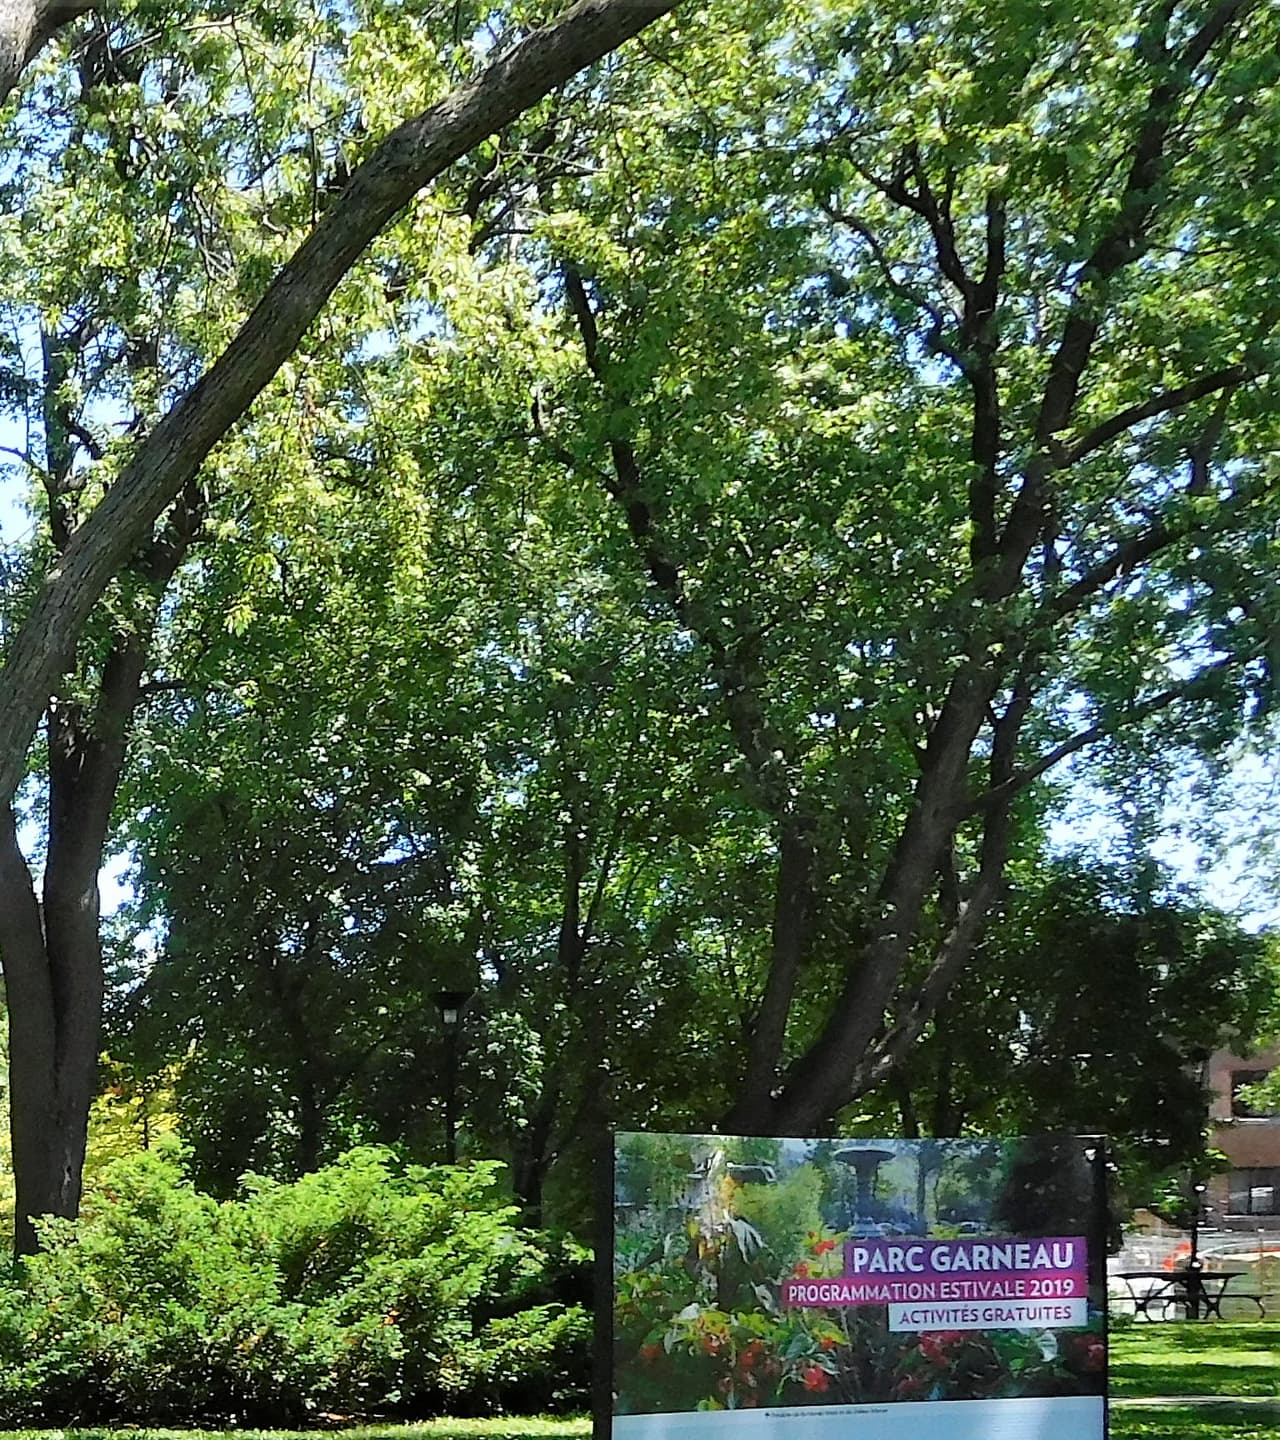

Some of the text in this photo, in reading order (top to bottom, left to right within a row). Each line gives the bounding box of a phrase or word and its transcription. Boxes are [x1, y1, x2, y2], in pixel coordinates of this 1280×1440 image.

[853, 1242, 1074, 1273] PARC GARNEAU
[788, 1278, 1074, 1302] PROGRAMMATION ESTIVALE 2019
[899, 1303, 1072, 1325] ACTIVITÉS GRATUITES
